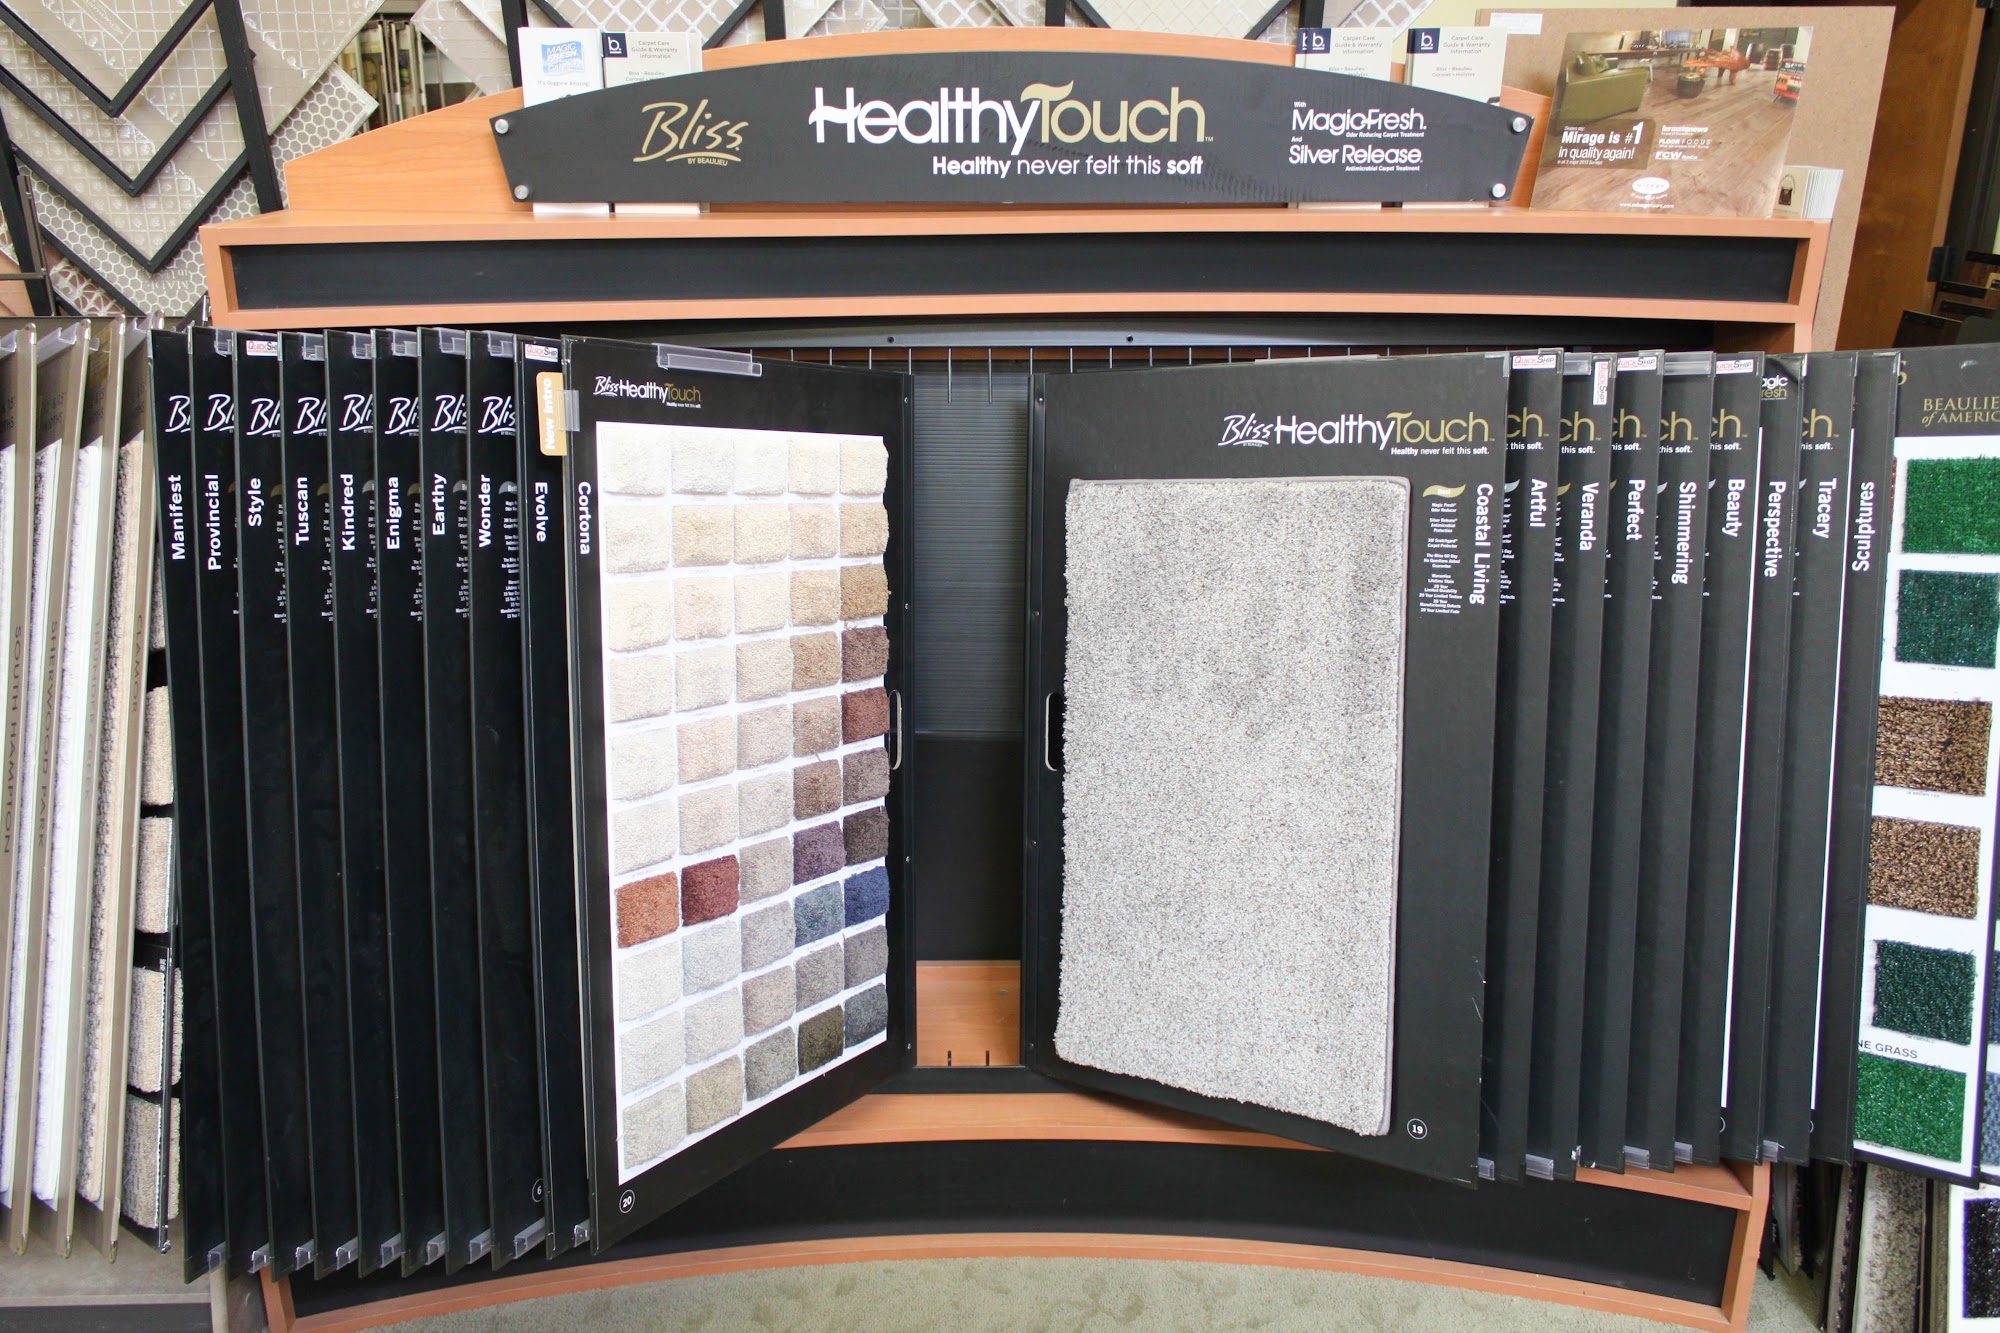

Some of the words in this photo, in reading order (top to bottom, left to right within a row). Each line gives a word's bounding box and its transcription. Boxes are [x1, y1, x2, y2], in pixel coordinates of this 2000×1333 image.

[547, 42, 577, 55] MAGIC
[547, 50, 577, 62] FRESH
[697, 158, 728, 166] BEAULIEU
[933, 156, 1011, 179] Healthy
[1017, 158, 1078, 175] never
[1086, 156, 1120, 175] felt
[1126, 156, 1161, 174] this
[1167, 156, 1203, 174] soft
[1289, 145, 1339, 164] Silver
[1558, 146, 1568, 158] in
[1569, 147, 1603, 161] quality
[1603, 147, 1635, 162] again!
[1561, 131, 1605, 146] Mirage
[1608, 131, 1620, 144] is
[543, 378, 554, 414] Intro
[1922, 412, 1938, 427] of
[544, 417, 555, 450] New
[1217, 413, 1274, 446] Bliss
[1391, 447, 1418, 456] Healthy
[1442, 447, 1455, 455] felt
[1456, 447, 1470, 455] this
[1473, 447, 1490, 455] soft.
[1510, 442, 1525, 450] this
[1526, 442, 1544, 450] soft.
[1561, 446, 1576, 454] this
[1578, 446, 1596, 454] soft.
[168, 474, 186, 560] Manifest
[205, 474, 222, 571] Provincial
[248, 477, 265, 527] Style
[295, 476, 310, 546] Tuscan
[341, 473, 356, 550] Kindred
[386, 476, 402, 550] Enigma
[432, 473, 448, 536] Earthy
[478, 474, 492, 548] Wonder
[535, 482, 549, 542] Evolve
[578, 481, 592, 555] Cortona
[1475, 483, 1494, 546] Coastal
[1529, 478, 1548, 527] Artful
[1579, 482, 1600, 551] Veranda
[1626, 479, 1646, 540] Perfect
[1722, 479, 1746, 538] Beauty
[1763, 481, 1787, 578] Perspective
[1812, 478, 1837, 539] Tracery
[1852, 481, 1876, 572] Sculptures
[1671, 481, 1697, 585] Shimmering
[1469, 553, 1491, 605] Living
[12, 626, 22, 711] SOUTH
[132, 614, 143, 713] CLAMOR
[42, 620, 58, 775] SHERWOOD
[4, 722, 17, 853] HAMPTON
[38, 785, 47, 848] PARK
[1875, 1042, 1918, 1060] GRASS
[1411, 1124, 1423, 1134] 19
[537, 1186, 542, 1195] 6
[623, 1195, 632, 1208] 20
